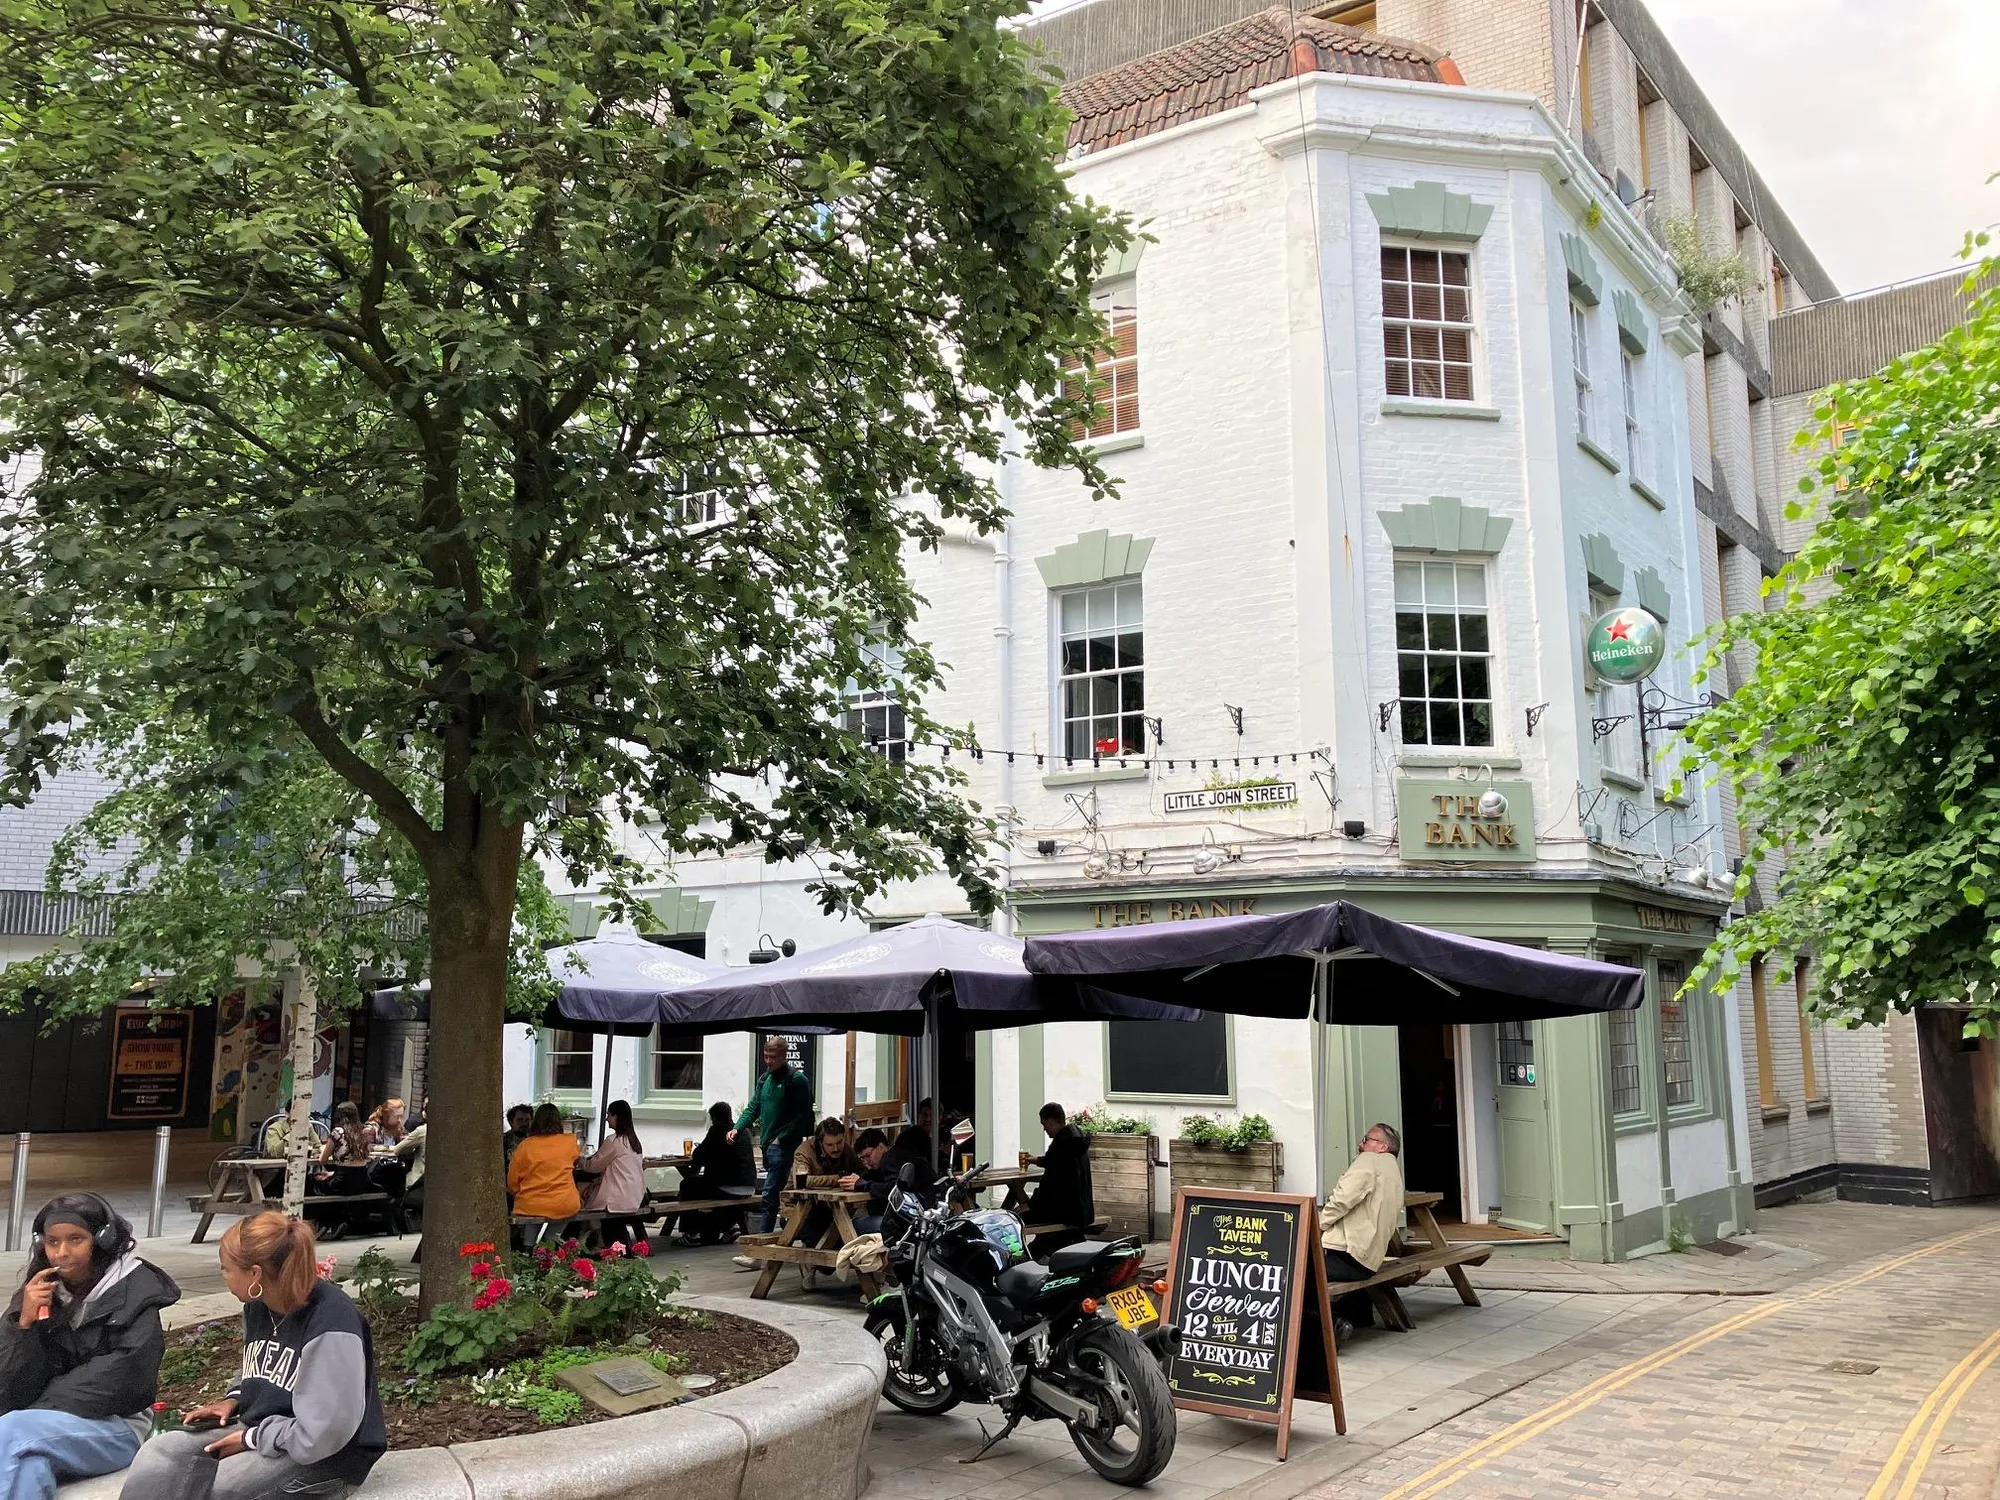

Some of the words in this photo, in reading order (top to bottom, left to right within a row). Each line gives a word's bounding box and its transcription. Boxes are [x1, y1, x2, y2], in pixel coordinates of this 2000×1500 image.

[1592, 644, 1654, 662] Heineken
[1168, 794, 1205, 809] LITTLE
[1209, 790, 1241, 805] JOHN
[1246, 786, 1293, 802] STREET
[1431, 793, 1483, 818] TH
[1424, 822, 1520, 846] BANK
[1088, 902, 1153, 928] THE
[1166, 899, 1257, 921] BANK
[135, 1060, 152, 1070] THIS
[155, 1060, 173, 1070] WAY
[1213, 1215, 1233, 1228] The
[1235, 1216, 1268, 1231] BANK
[1218, 1228, 1262, 1245] TAVERN
[1188, 1256, 1283, 1293] LUNCH
[1110, 1288, 1145, 1311] RX04
[1185, 1286, 1281, 1320] Served
[1127, 1304, 1151, 1324] JBE
[1181, 1311, 1209, 1338] 12
[1241, 1320, 1261, 1345] 4
[1264, 1322, 1276, 1346] PM
[1180, 1340, 1275, 1370] EVERYDAY
